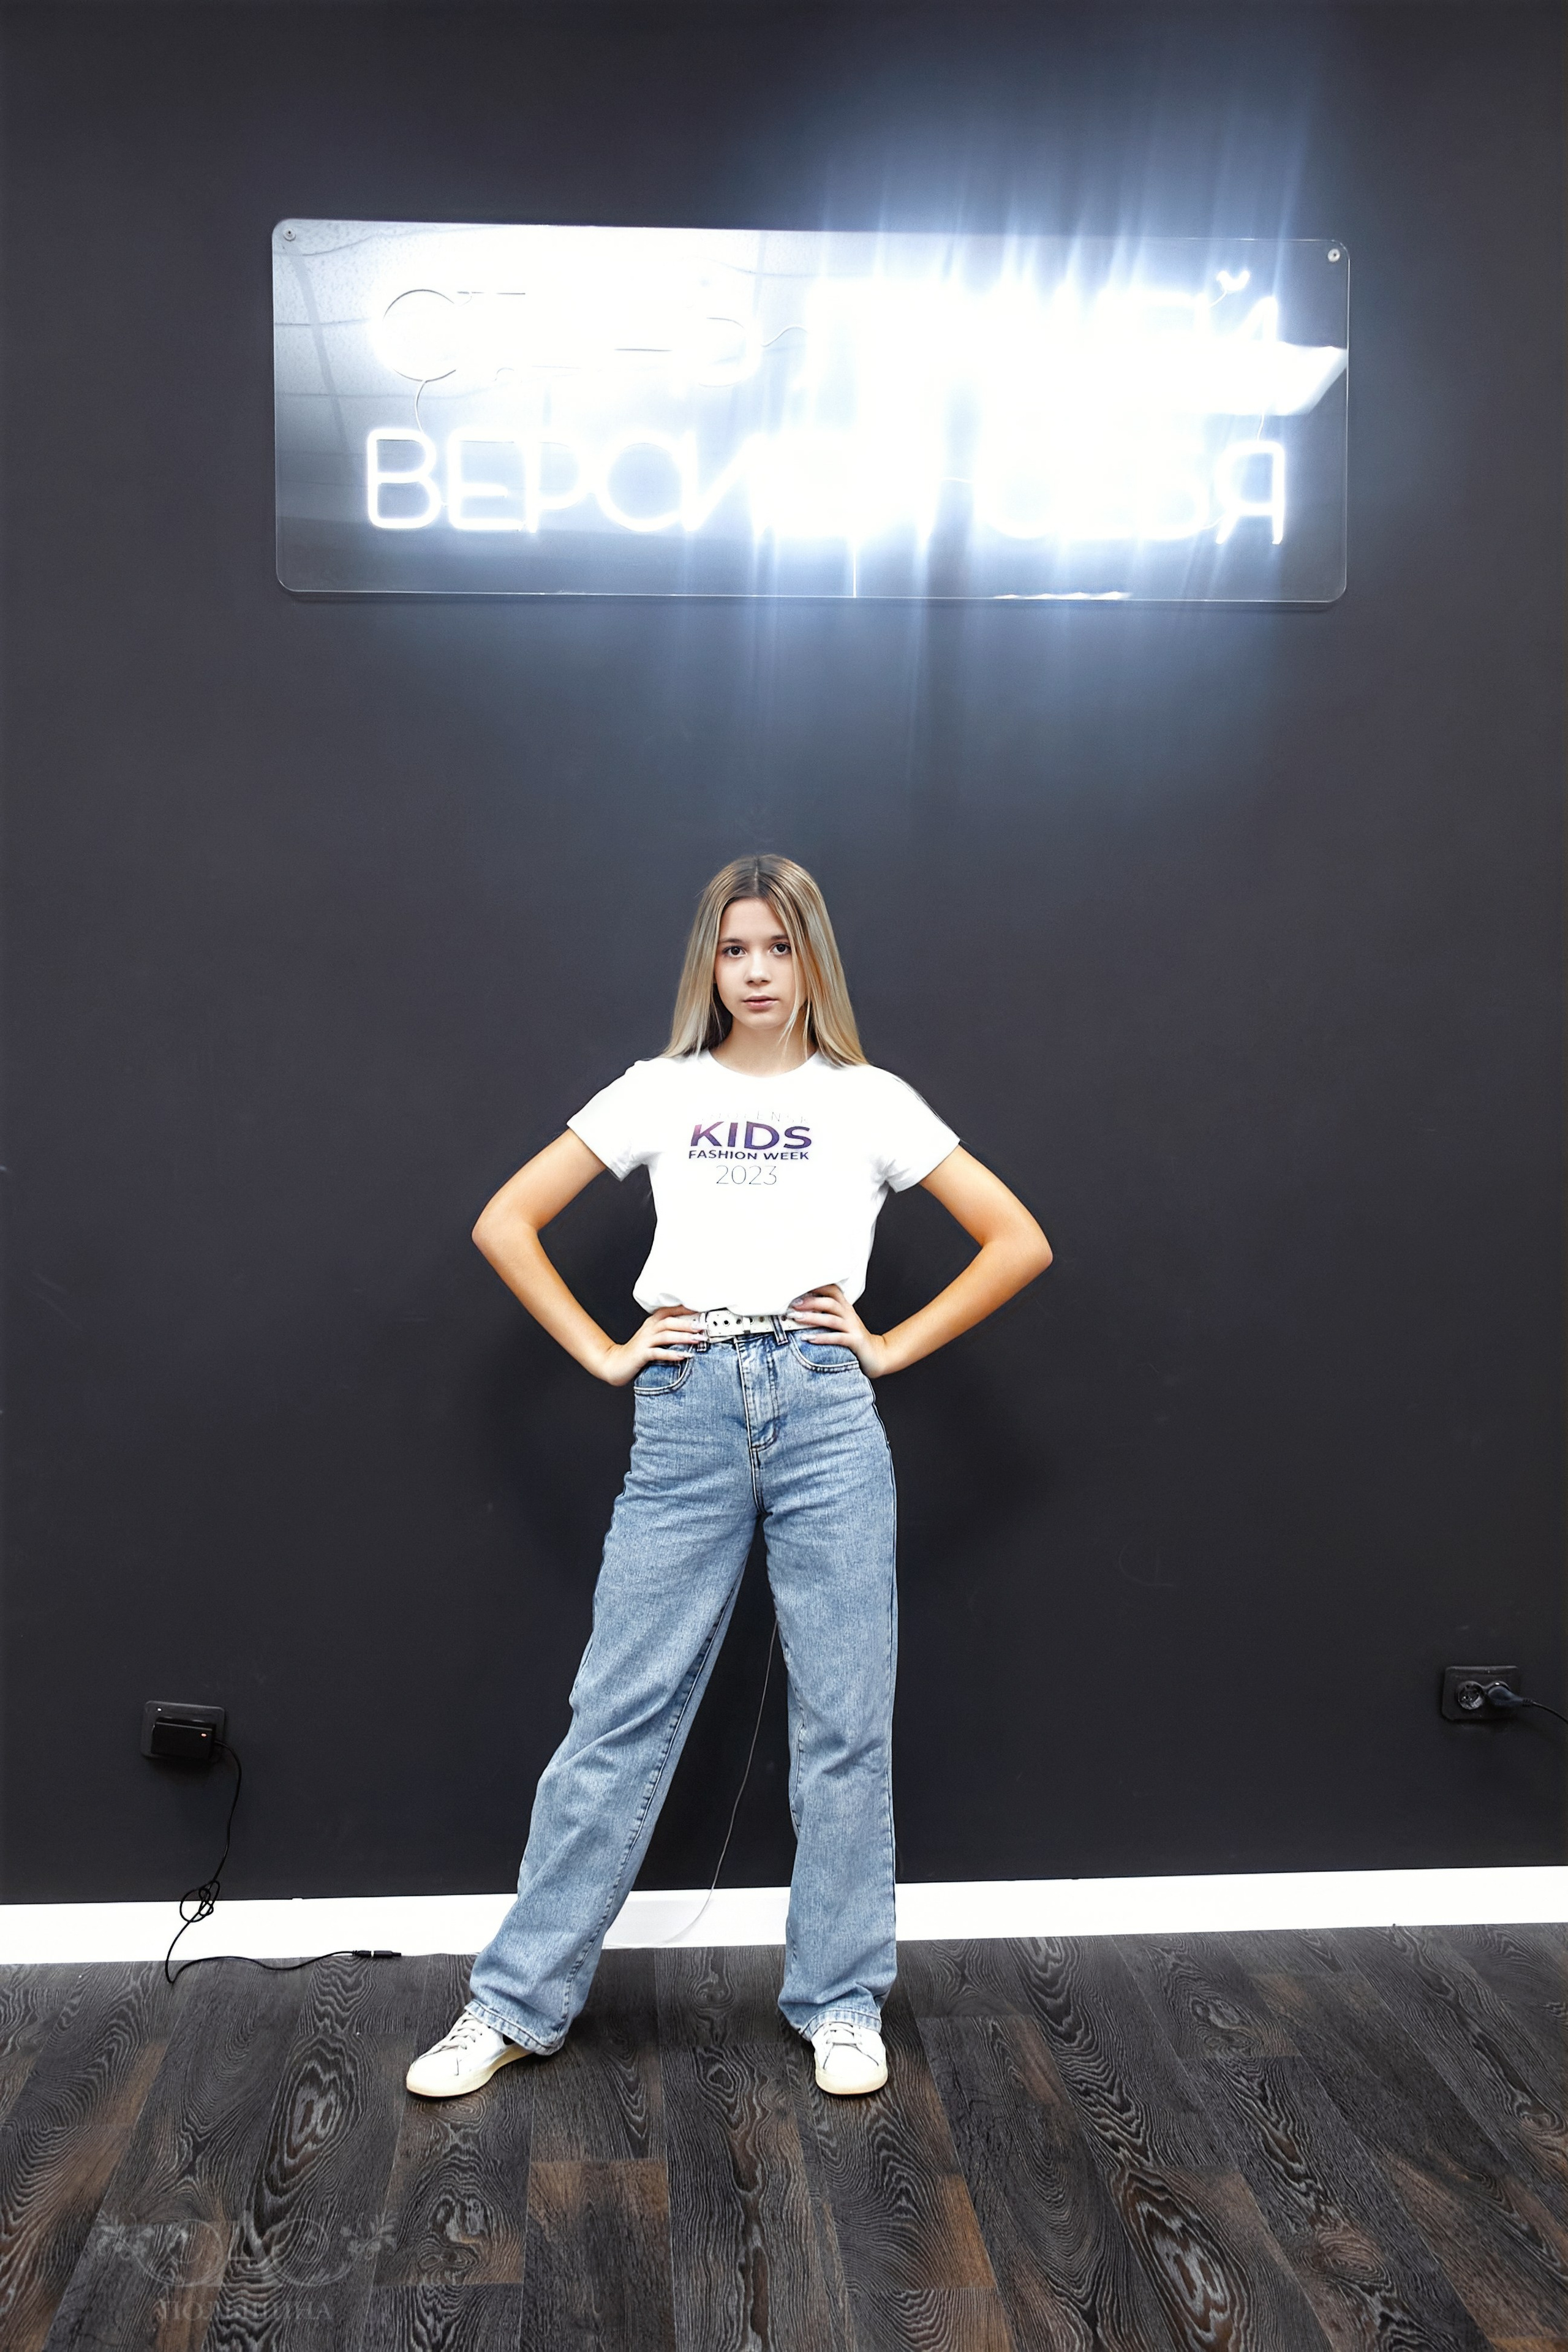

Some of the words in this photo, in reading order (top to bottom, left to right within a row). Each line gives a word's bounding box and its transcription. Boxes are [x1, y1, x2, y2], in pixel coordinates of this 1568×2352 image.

[690, 1121, 812, 1150] KIDS
[688, 1150, 757, 1160] FASHION
[763, 1152, 809, 1160] WEEK
[716, 1165, 777, 1185] 2023
